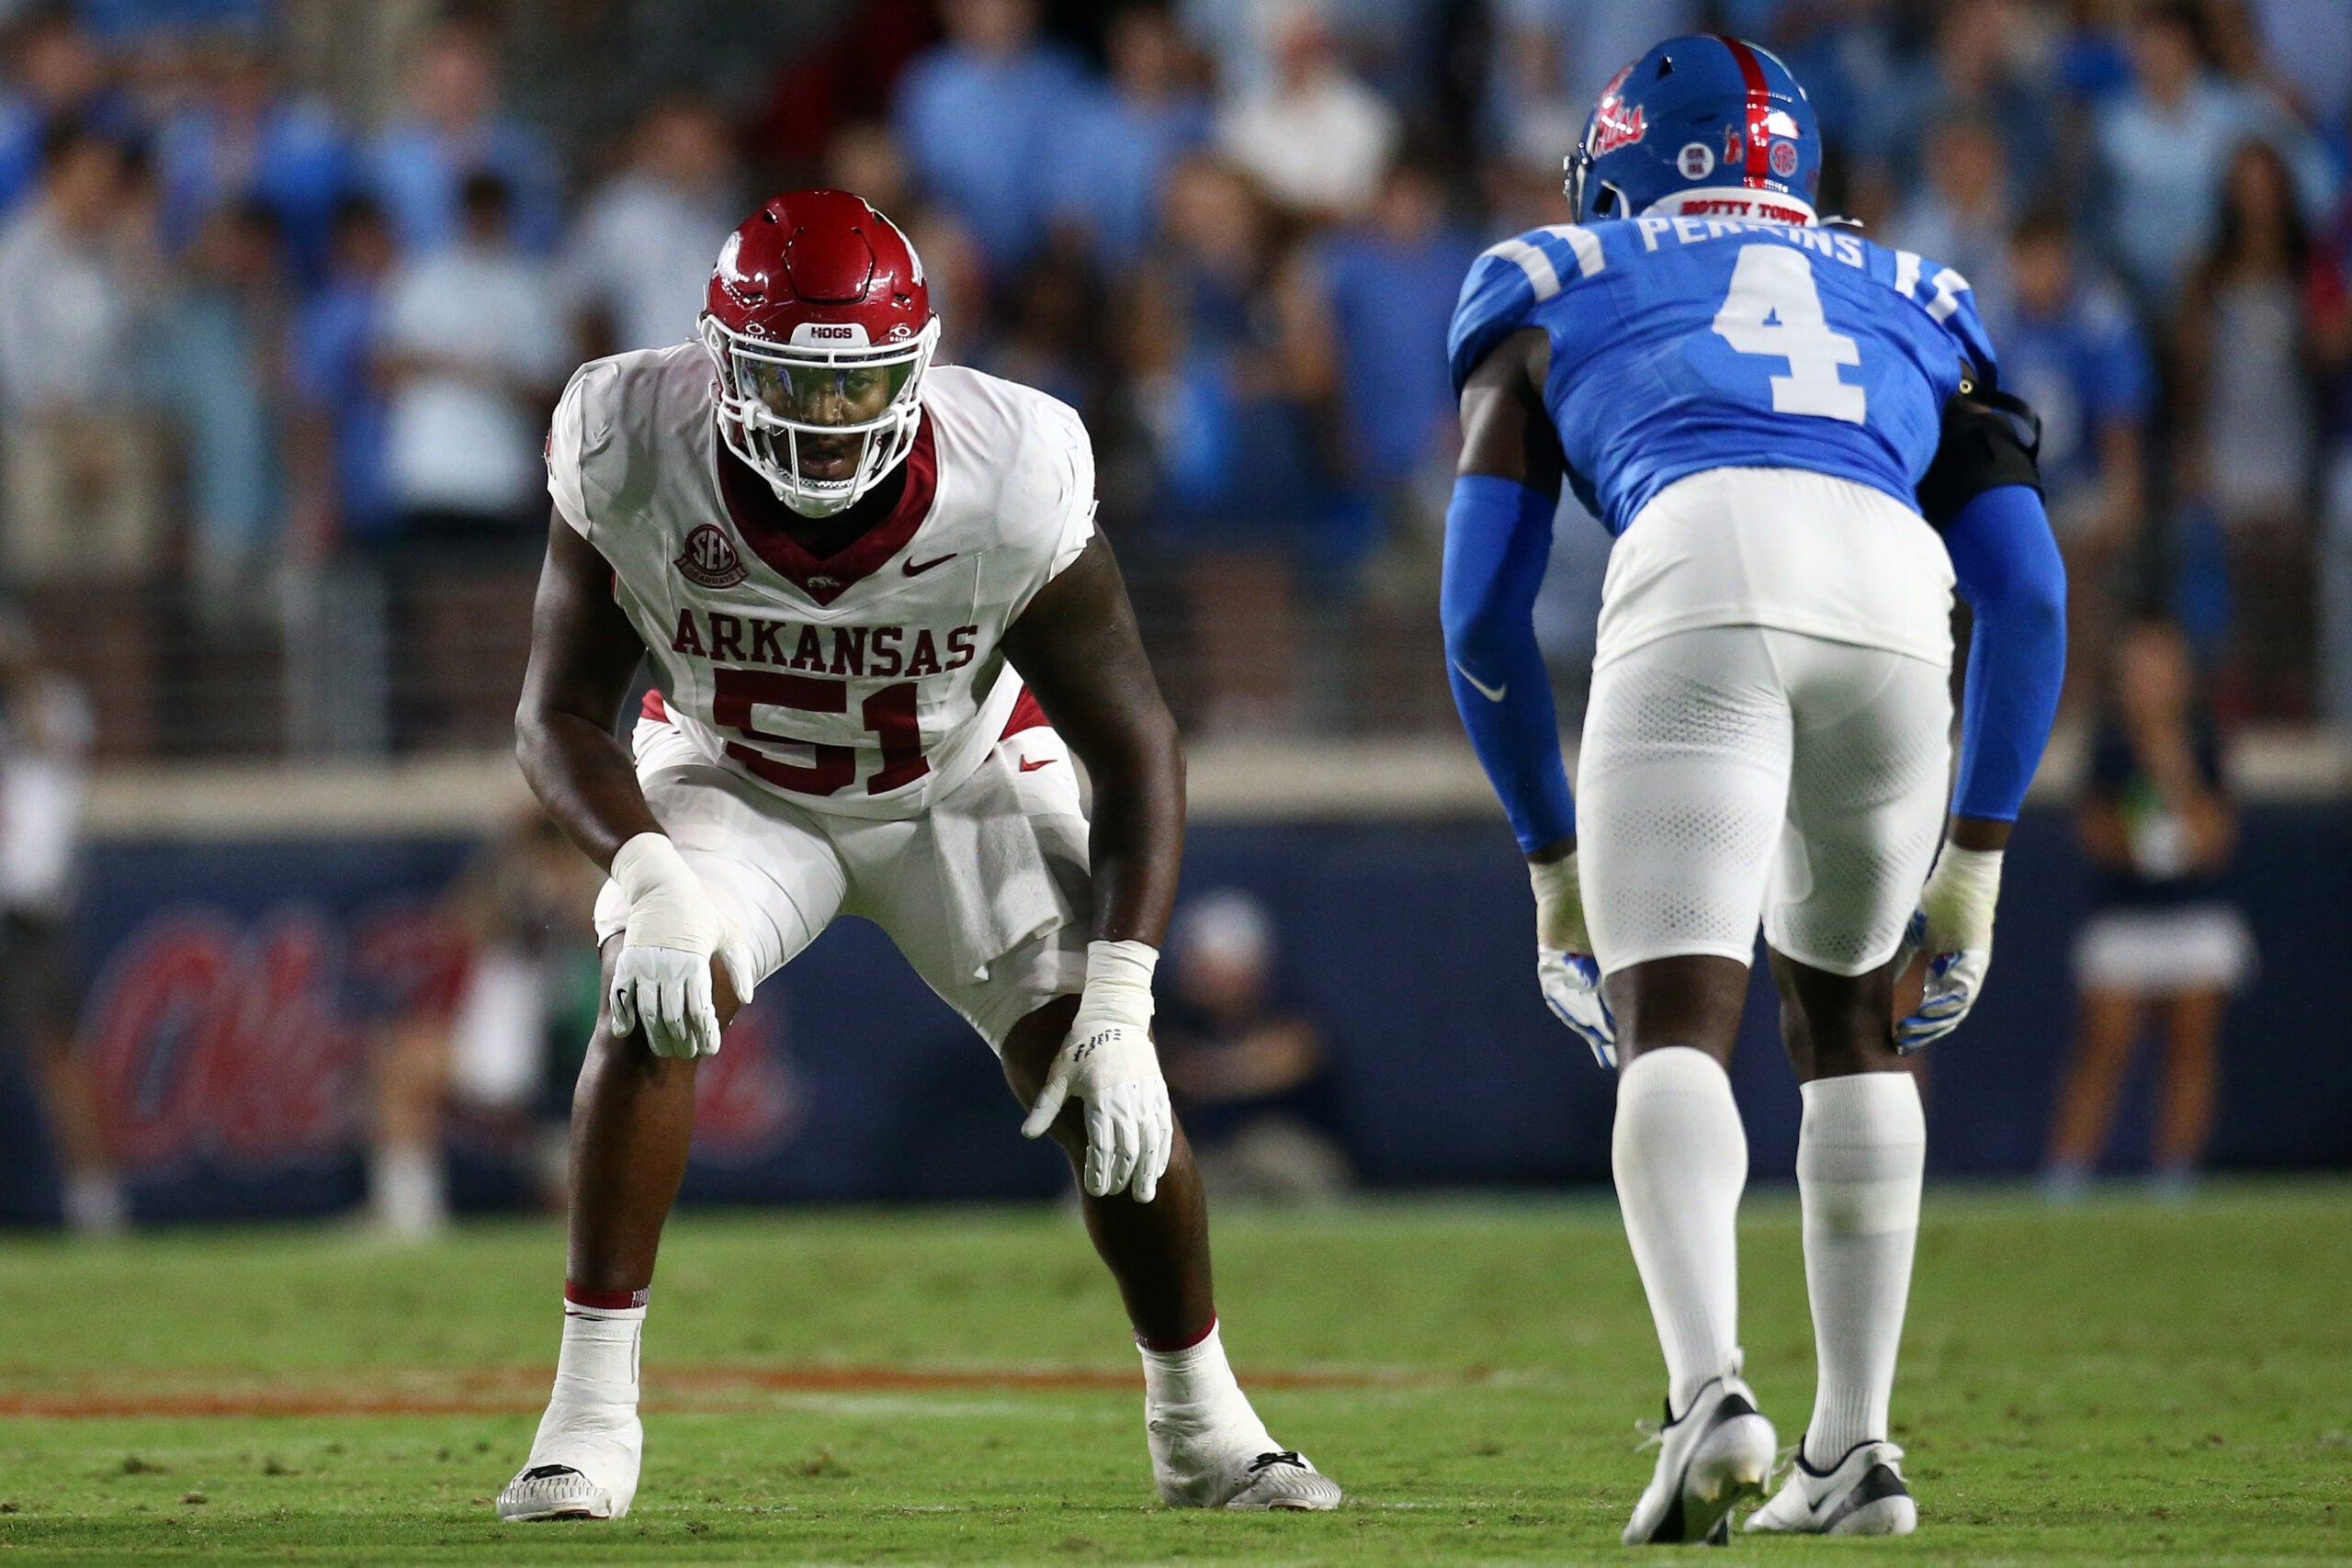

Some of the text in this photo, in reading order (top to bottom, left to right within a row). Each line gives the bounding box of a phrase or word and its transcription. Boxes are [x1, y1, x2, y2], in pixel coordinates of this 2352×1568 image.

[1681, 200, 1752, 216] HOTTY
[810, 327, 853, 339] HOGS
[1712, 243, 1867, 425] 4
[691, 529, 732, 570] SEC
[686, 566, 736, 584] GRADUATE
[672, 608, 978, 677] ARKANSAS
[713, 667, 932, 797] 51
